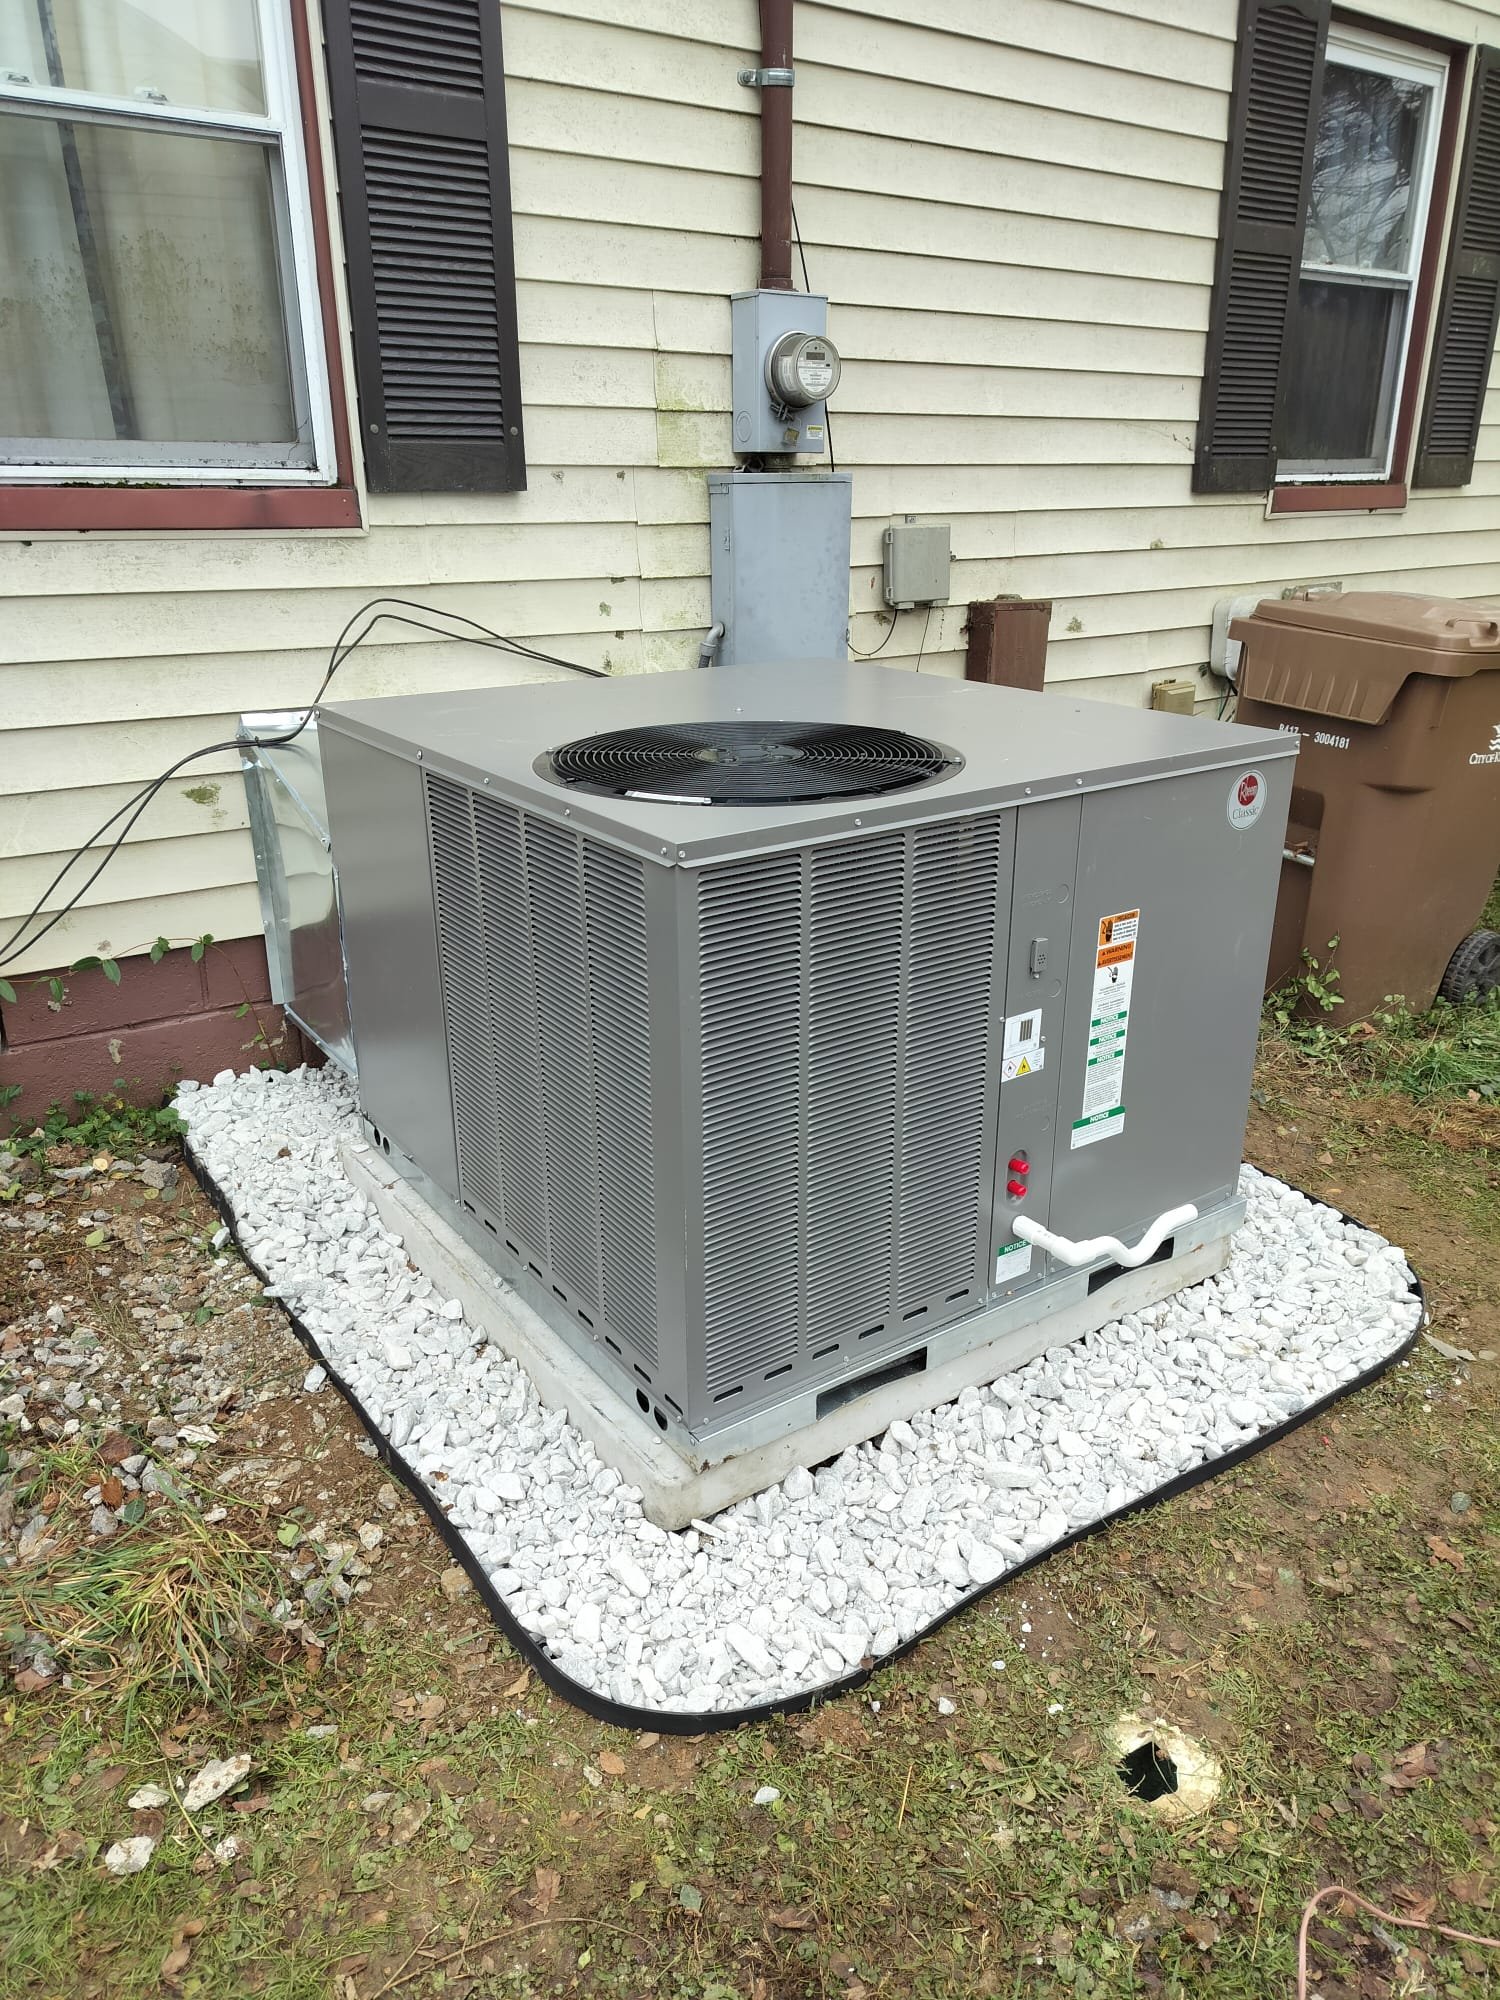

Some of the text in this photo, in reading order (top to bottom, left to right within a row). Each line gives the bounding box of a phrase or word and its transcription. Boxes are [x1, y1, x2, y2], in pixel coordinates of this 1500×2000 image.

[1314, 731, 1350, 750] 3004181
[1232, 806, 1258, 820] Classic
[1100, 1013, 1119, 1024] NOTICE
[1098, 1032, 1117, 1043] NOTICE
[1096, 1051, 1115, 1063] NOTICE
[1089, 1111, 1110, 1123] NOTICE
[1004, 1240, 1027, 1253] NOTICE
